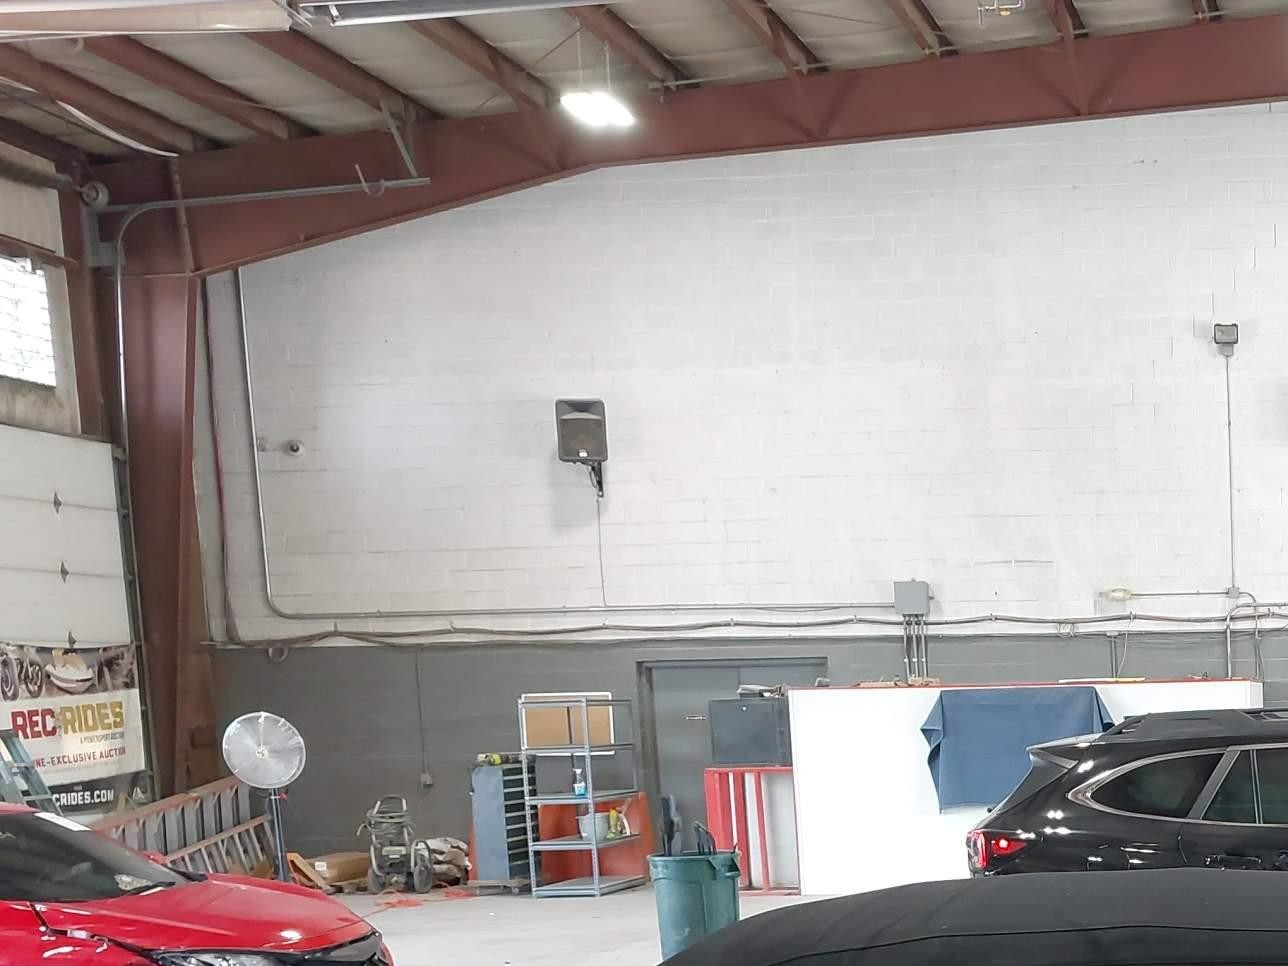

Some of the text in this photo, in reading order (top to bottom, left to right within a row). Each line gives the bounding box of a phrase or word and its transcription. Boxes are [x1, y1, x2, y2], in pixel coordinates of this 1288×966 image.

[11, 701, 125, 740] REC RIDES
[52, 789, 114, 808] CRIDES.COM
